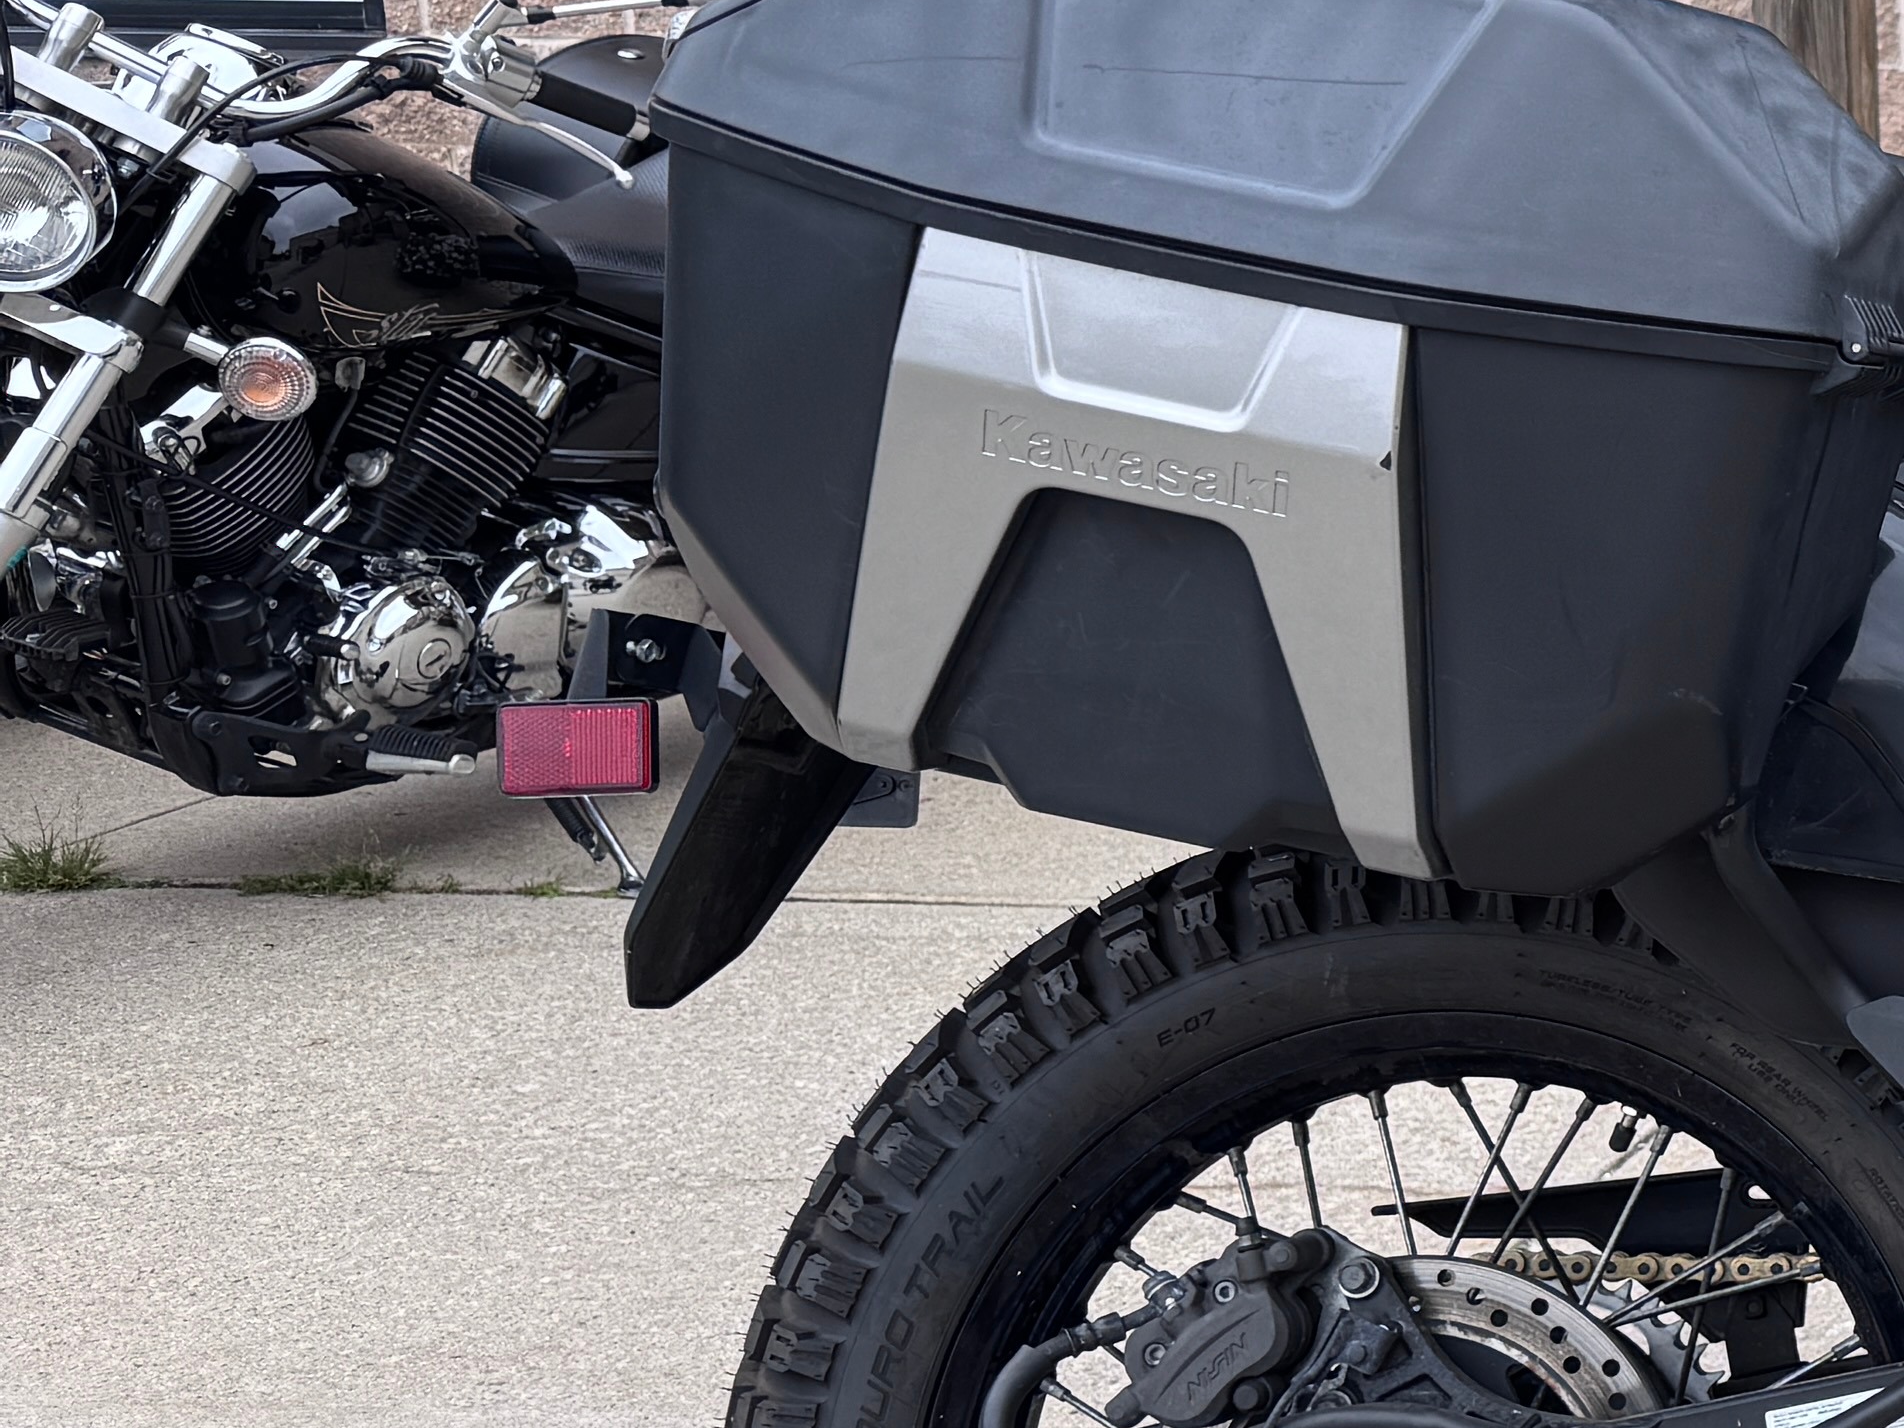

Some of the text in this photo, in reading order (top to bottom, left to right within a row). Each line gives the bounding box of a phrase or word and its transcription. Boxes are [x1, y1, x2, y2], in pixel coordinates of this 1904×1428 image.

[980, 408, 1291, 518] Kawasaki
[1156, 1008, 1216, 1048] E-07
[903, 1176, 1004, 1302] TRAIL
